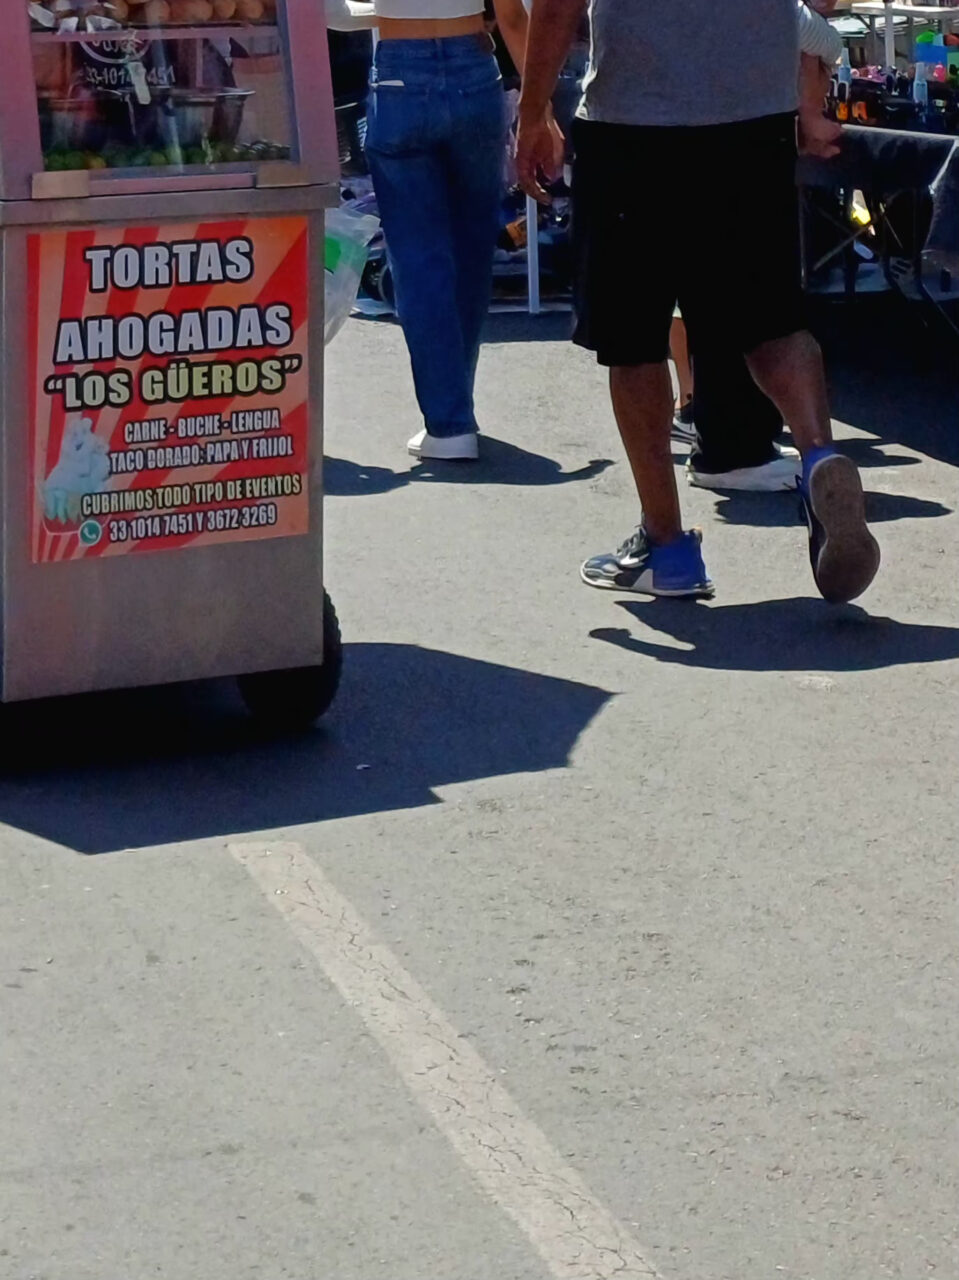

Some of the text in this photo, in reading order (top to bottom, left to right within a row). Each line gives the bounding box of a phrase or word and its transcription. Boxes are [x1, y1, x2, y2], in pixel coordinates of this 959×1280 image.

[85, 239, 253, 290] TORTAS
[55, 305, 291, 362] AHOGADAS
[124, 420, 167, 442] CARNE
[178, 415, 221, 437] BUCHE
[231, 410, 280, 433] LENGUA
[110, 452, 144, 473] TACO
[206, 440, 240, 463] PAPA
[241, 439, 251, 459] Y
[252, 436, 293, 458] FRIJOL
[82, 474, 301, 515] CUBRIMOS TODO TIPO DE EVENTOS
[109, 504, 277, 541] 33 1014 7451 Y 3672 3269
